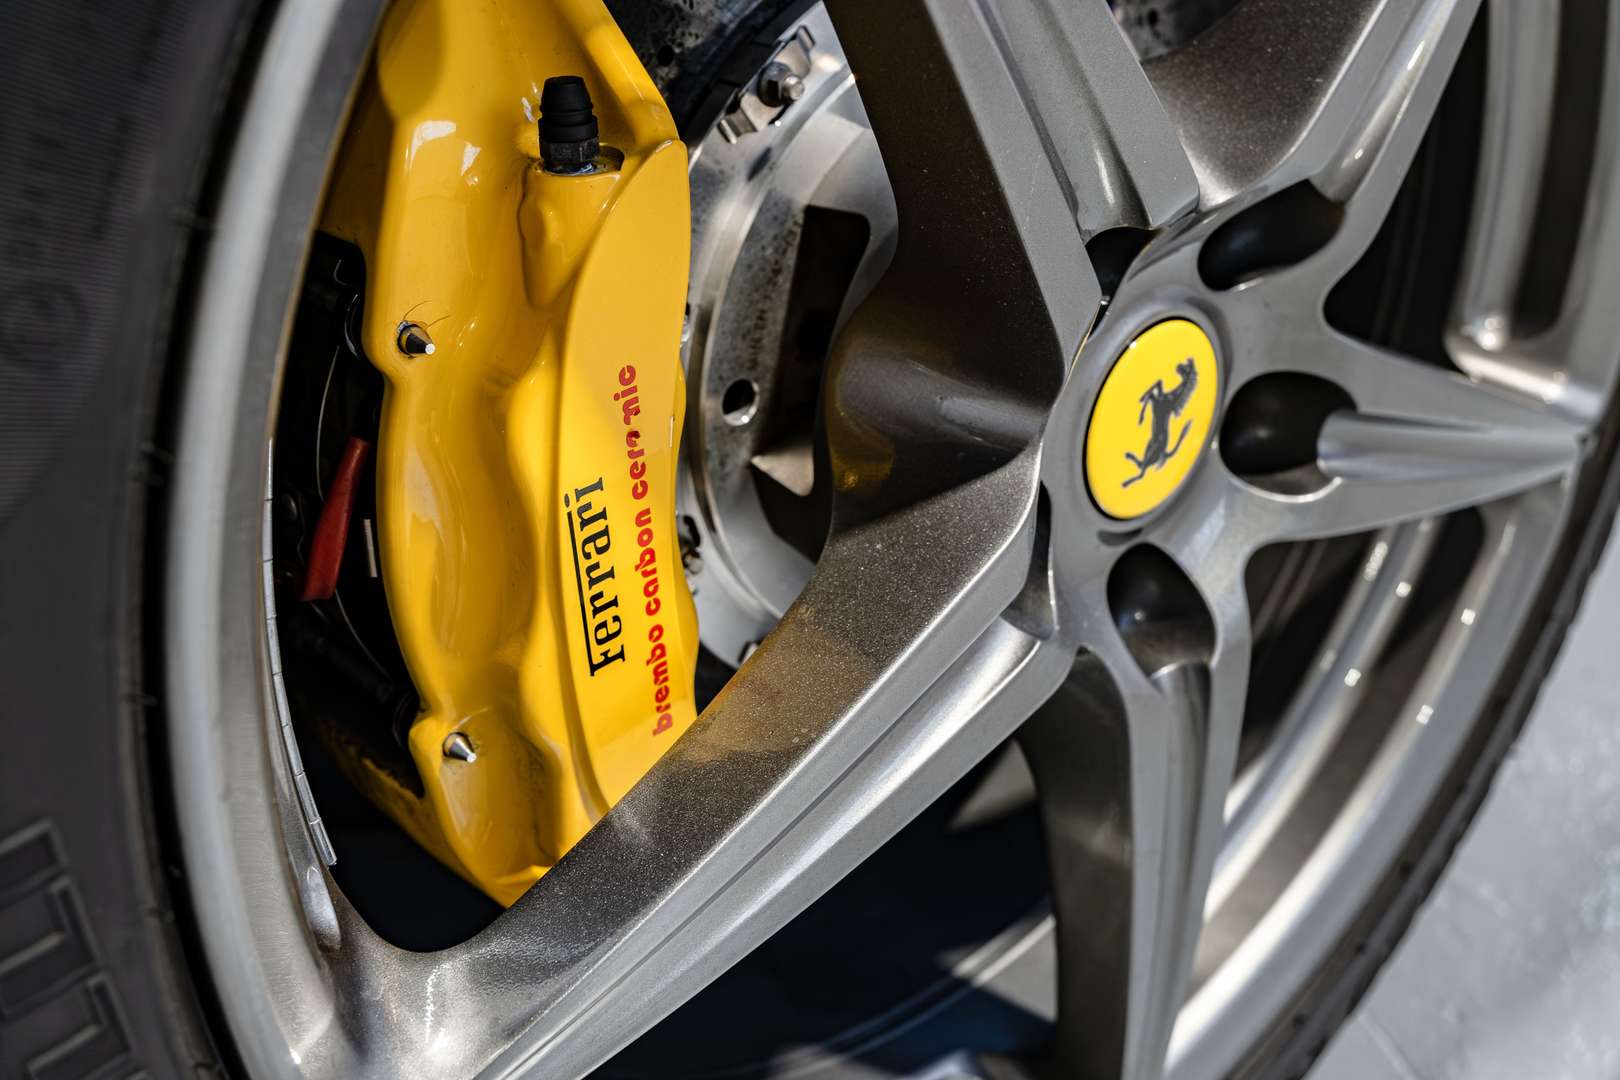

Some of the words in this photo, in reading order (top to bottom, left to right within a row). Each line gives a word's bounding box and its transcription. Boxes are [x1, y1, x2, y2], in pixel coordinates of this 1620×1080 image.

[564, 477, 626, 677] Ferrari
[634, 507, 661, 617] carbon
[645, 623, 673, 736] brembo
